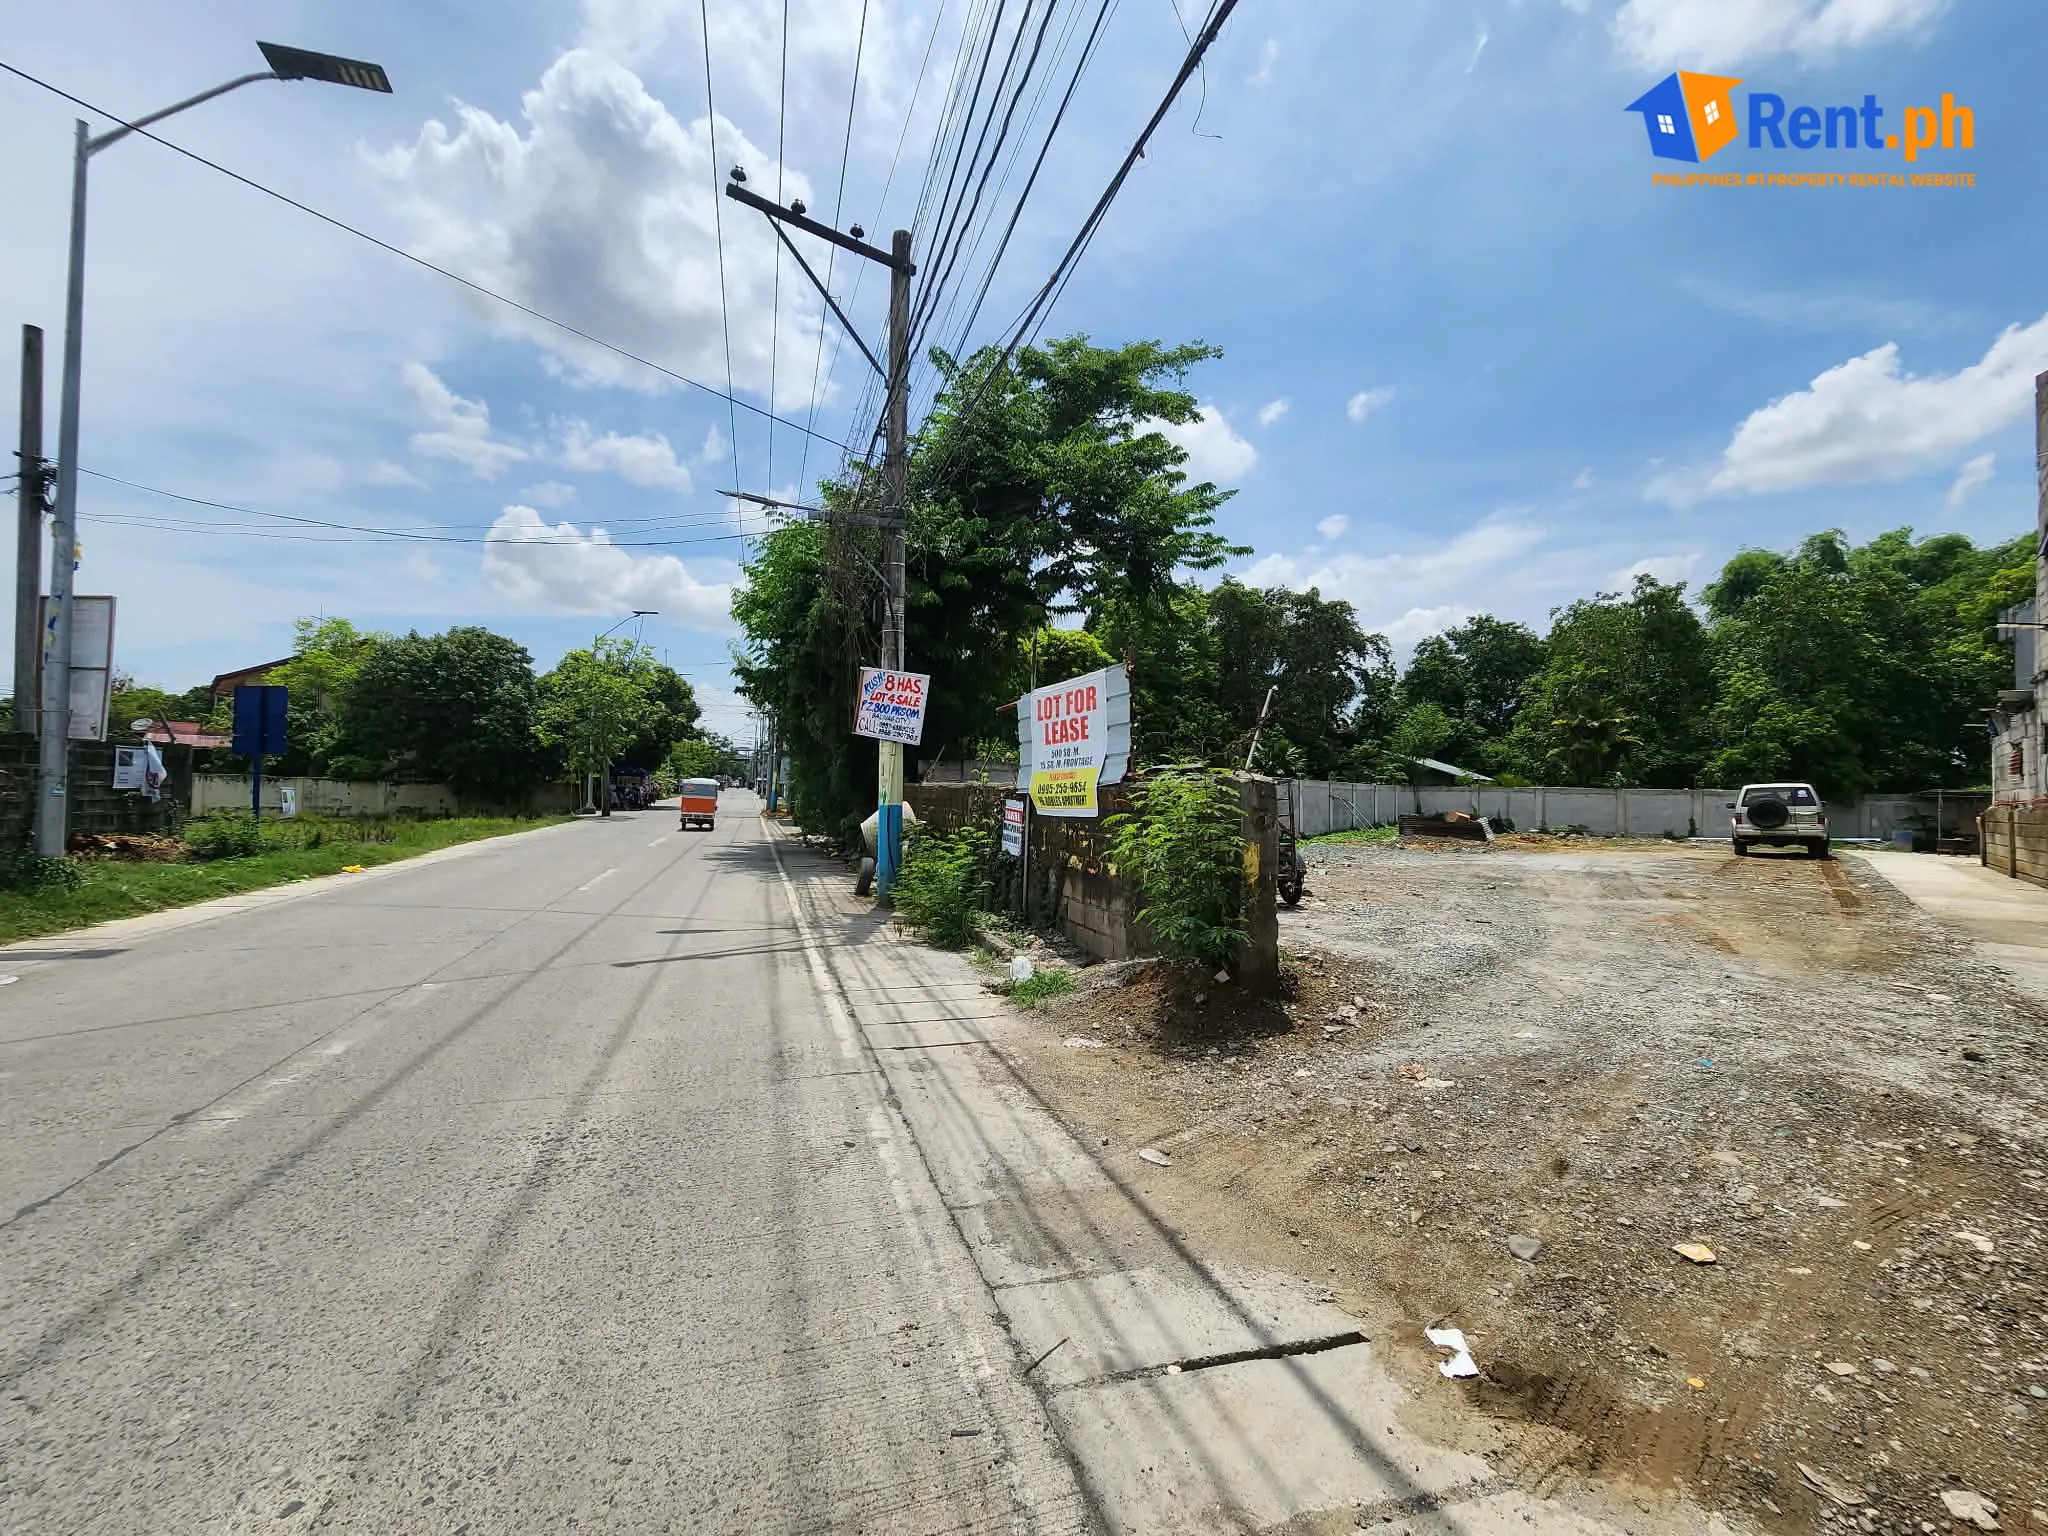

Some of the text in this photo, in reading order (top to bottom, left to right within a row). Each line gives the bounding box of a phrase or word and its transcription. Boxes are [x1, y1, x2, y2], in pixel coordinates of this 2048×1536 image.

[884, 675, 895, 691] 8
[870, 689, 921, 707] LOT 4 SALE
[1036, 685, 1097, 722] LOT FOR
[1044, 715, 1089, 746] LEASE
[1051, 749, 1063, 759] 500
[1063, 756, 1093, 768] FRONTAGE
